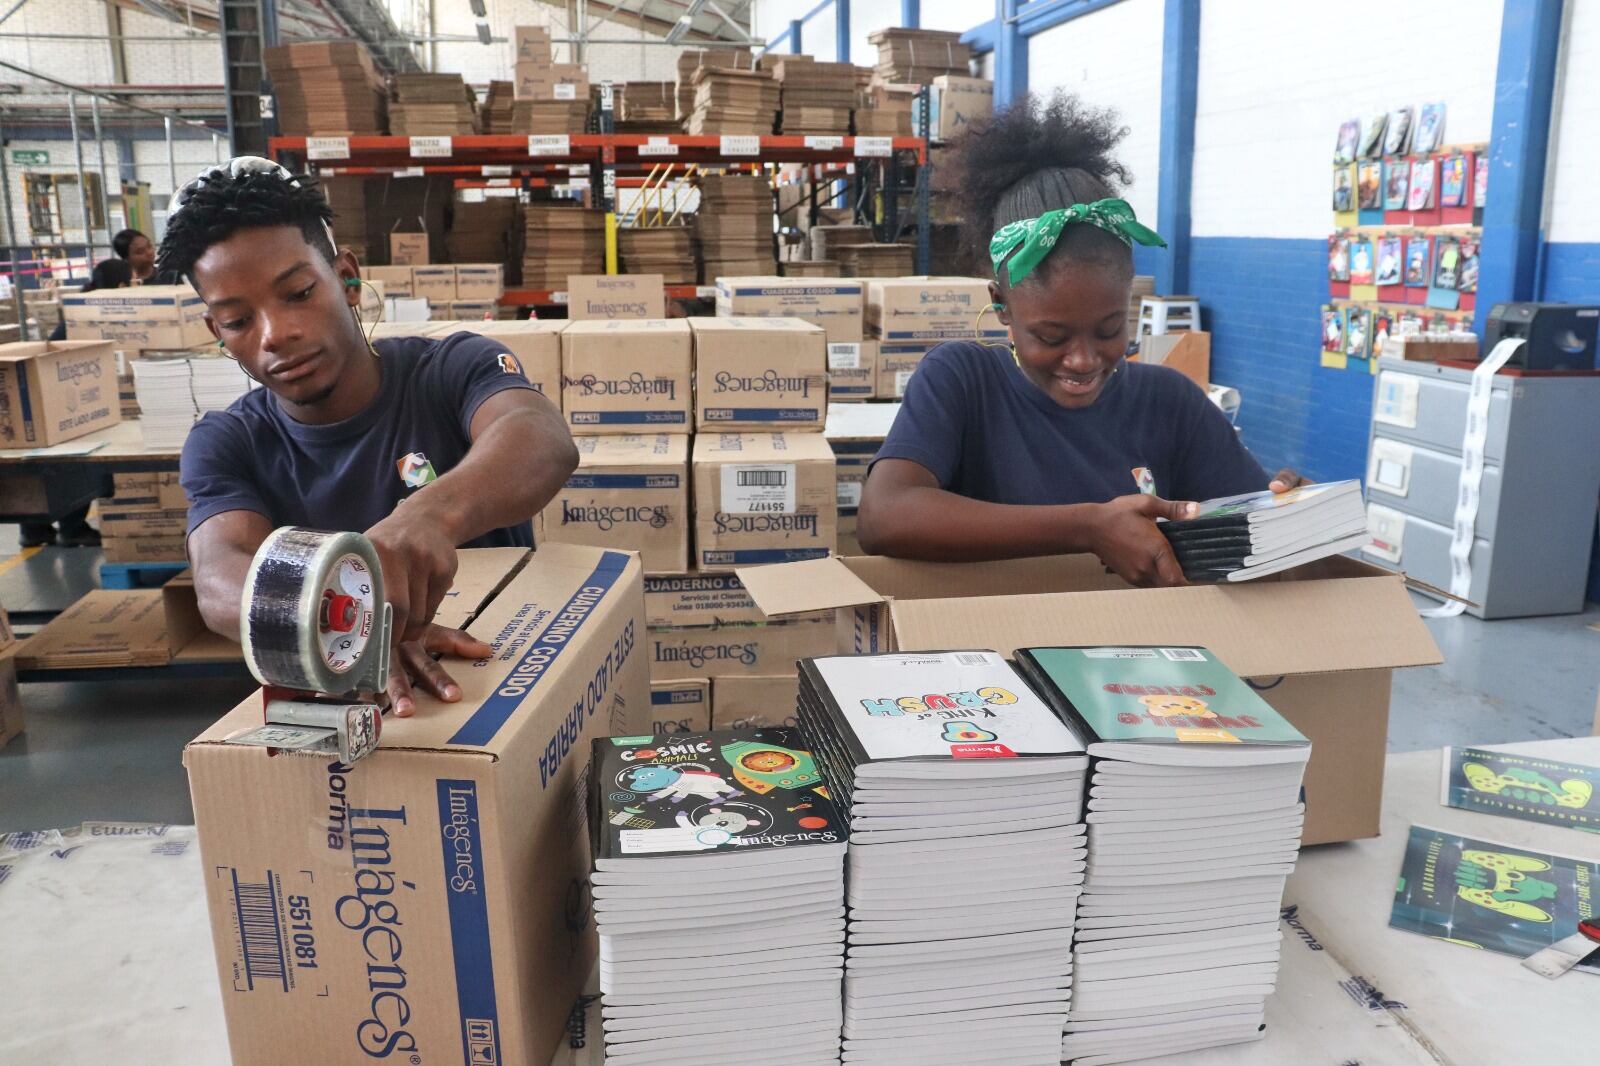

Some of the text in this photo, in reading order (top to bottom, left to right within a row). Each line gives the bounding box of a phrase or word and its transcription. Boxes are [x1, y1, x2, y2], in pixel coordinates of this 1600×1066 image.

[749, 502, 785, 512] 551177
[643, 578, 724, 592] CUADERNO
[681, 592, 747, 602] Servicio al Cliente
[526, 609, 551, 632] Servicio
[498, 586, 604, 697] CUADERNO COSIDO
[498, 638, 523, 662] Cliente
[538, 617, 634, 791] ESTE LADO ARRIBA
[859, 686, 1019, 718] CRUSH
[940, 707, 997, 721] KING
[620, 742, 712, 761] COSMIC
[651, 753, 698, 765] ANIMALS
[287, 895, 319, 969] 551081
[1280, 903, 1324, 951] Norma
